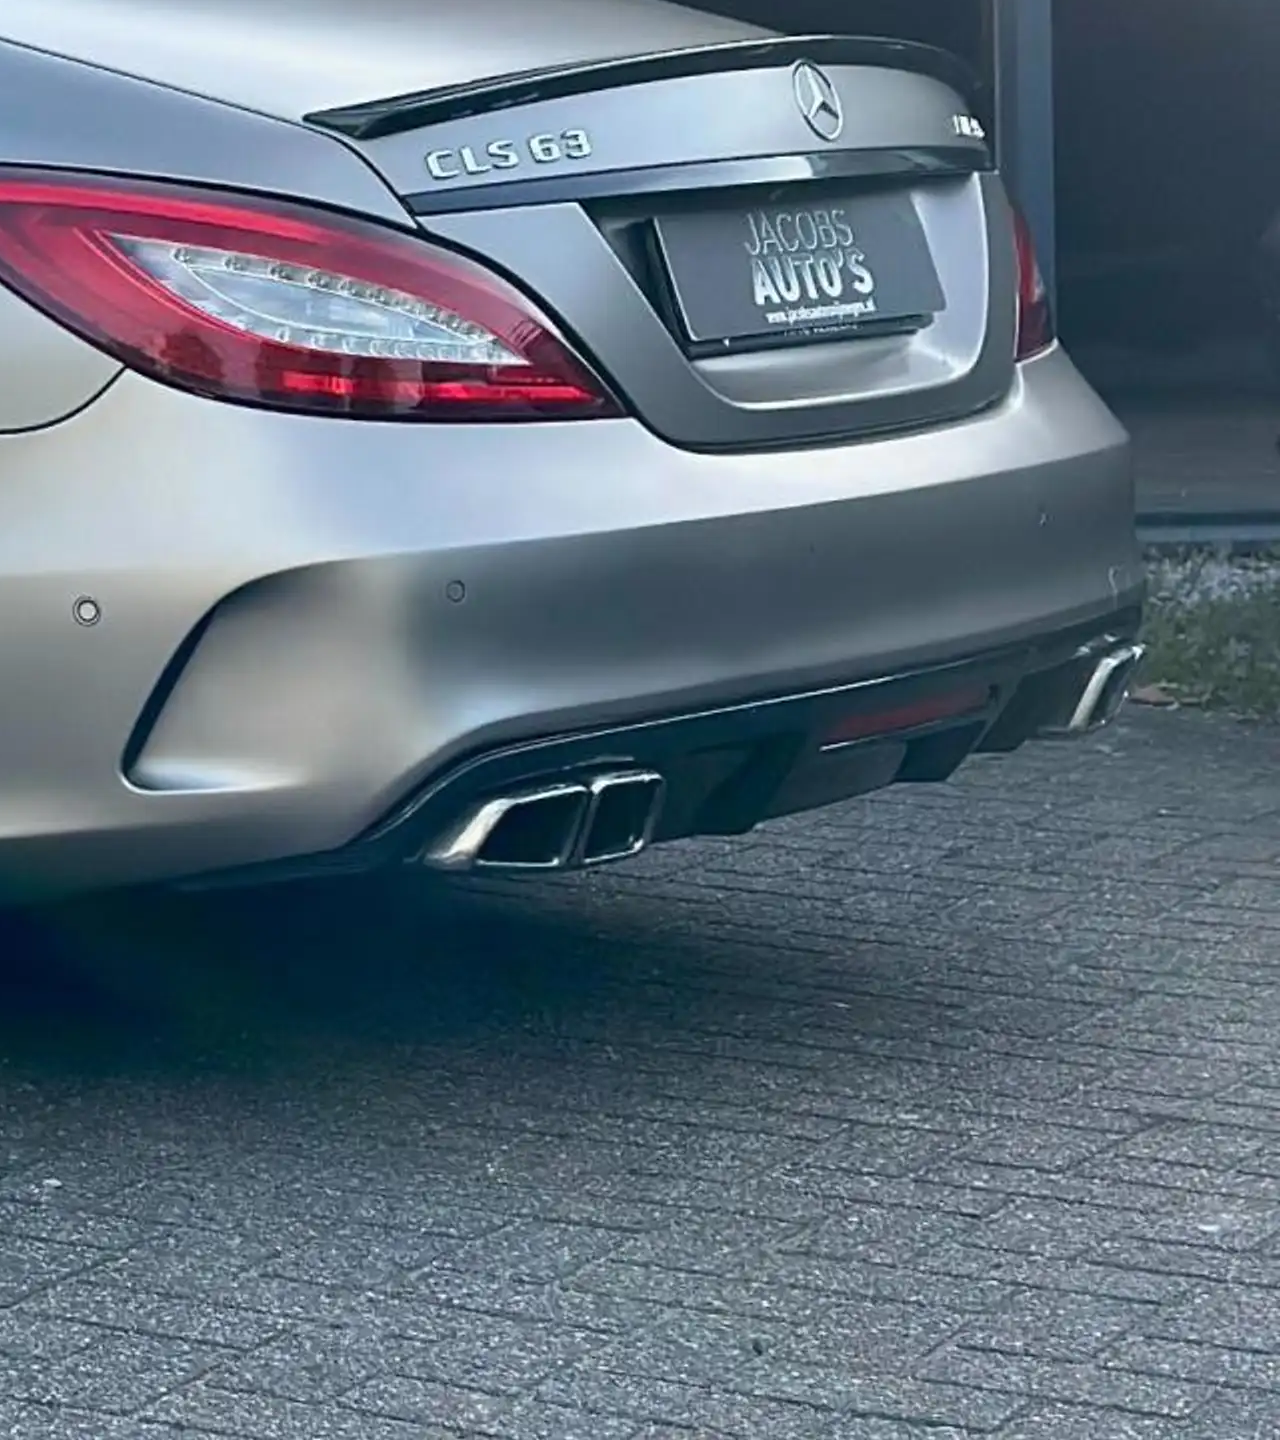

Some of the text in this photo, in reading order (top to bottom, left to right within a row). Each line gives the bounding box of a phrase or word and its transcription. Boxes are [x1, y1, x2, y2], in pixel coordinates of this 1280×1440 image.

[425, 128, 592, 180] CLS 63
[744, 210, 853, 255] JACOBS
[752, 246, 874, 305] AUTO'S
